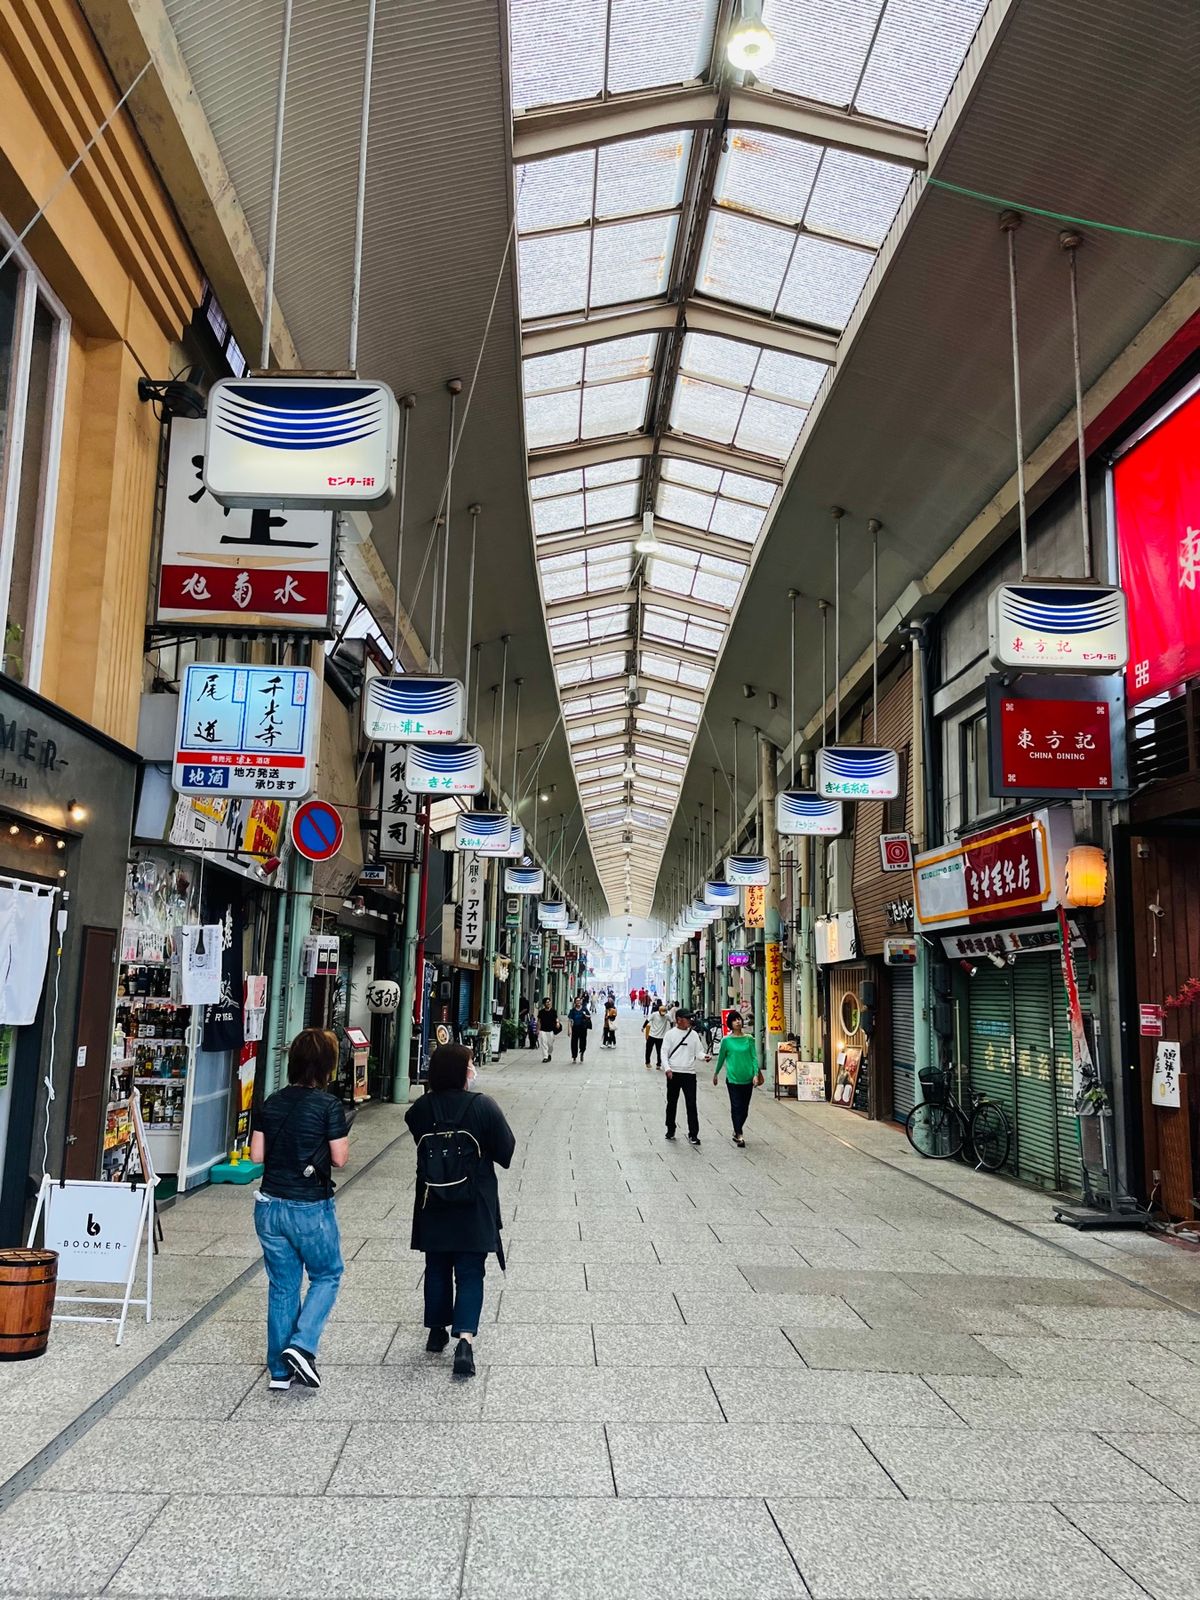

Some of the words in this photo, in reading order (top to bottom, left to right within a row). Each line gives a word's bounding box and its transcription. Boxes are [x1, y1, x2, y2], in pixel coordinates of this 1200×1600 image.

[327, 475, 375, 488] センター街
[1012, 637, 1072, 653] 東方記
[1083, 653, 1117, 661] センター街
[194, 674, 229, 743] 尾道
[255, 676, 284, 747] 千光寺
[400, 719, 427, 737] 浦上
[1017, 728, 1096, 750] 東方記
[1029, 752, 1053, 760] CHINA
[1056, 752, 1085, 761] DINING
[188, 768, 224, 786] 地酒
[234, 767, 280, 779] 地方発送
[255, 779, 297, 791] 承ります
[427, 777, 454, 789] きそ
[825, 782, 870, 794] きそ毛糸店
[464, 899, 479, 946] アオヤマ
